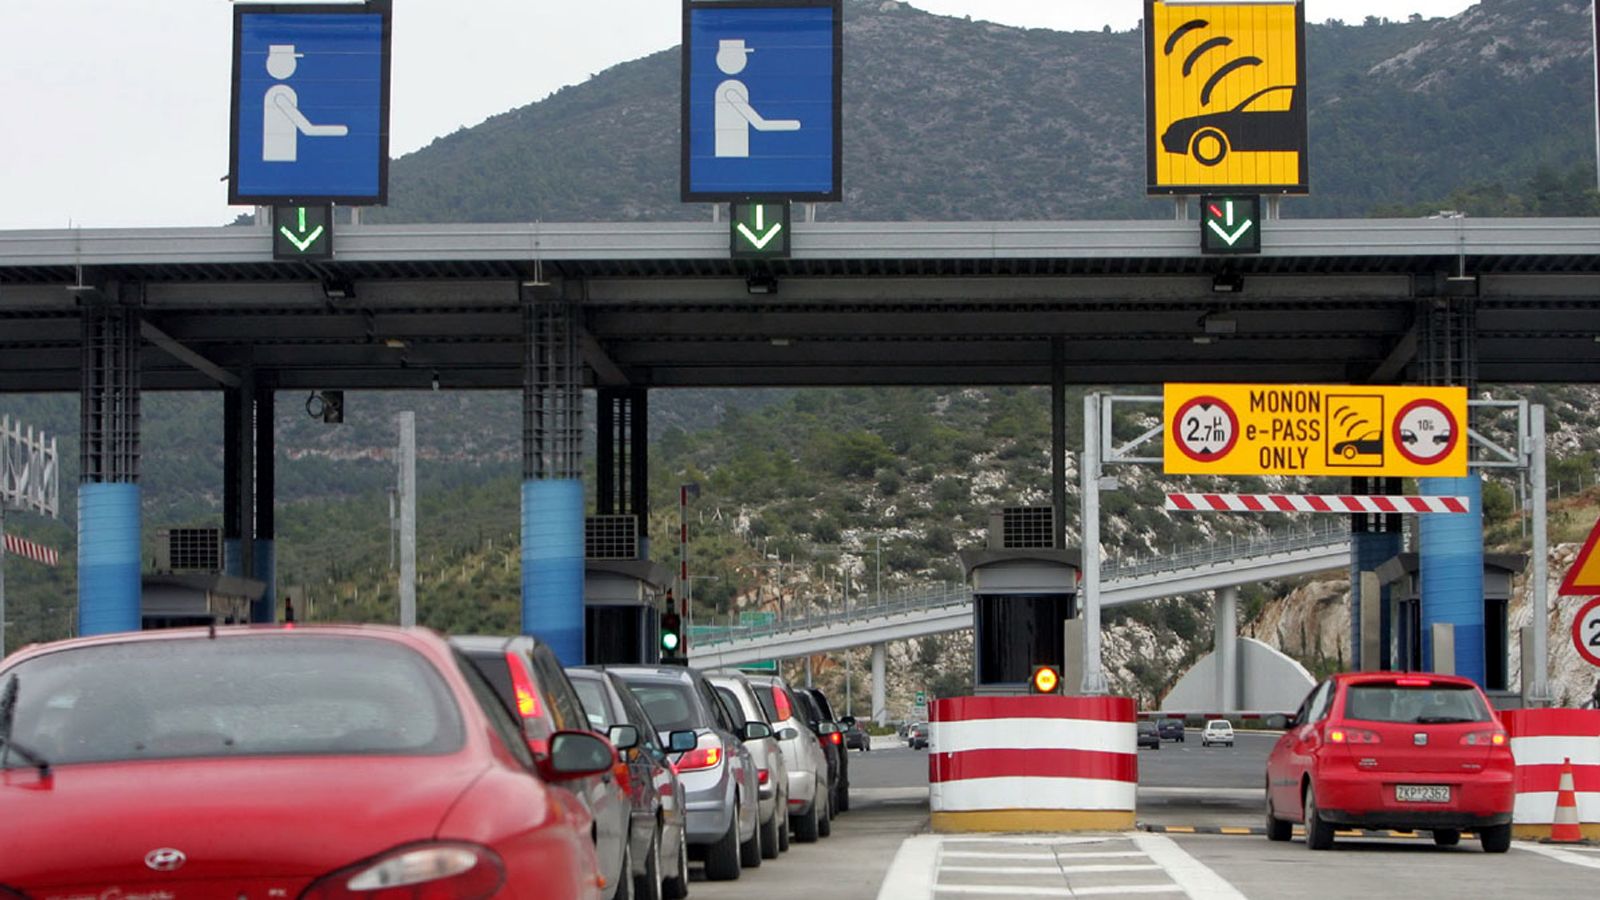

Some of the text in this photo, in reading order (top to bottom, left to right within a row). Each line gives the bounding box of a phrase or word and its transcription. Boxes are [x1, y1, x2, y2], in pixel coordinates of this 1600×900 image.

[1250, 390, 1320, 413] MONON
[1246, 418, 1320, 441] e-PASS
[1260, 446, 1308, 469] ONLY
